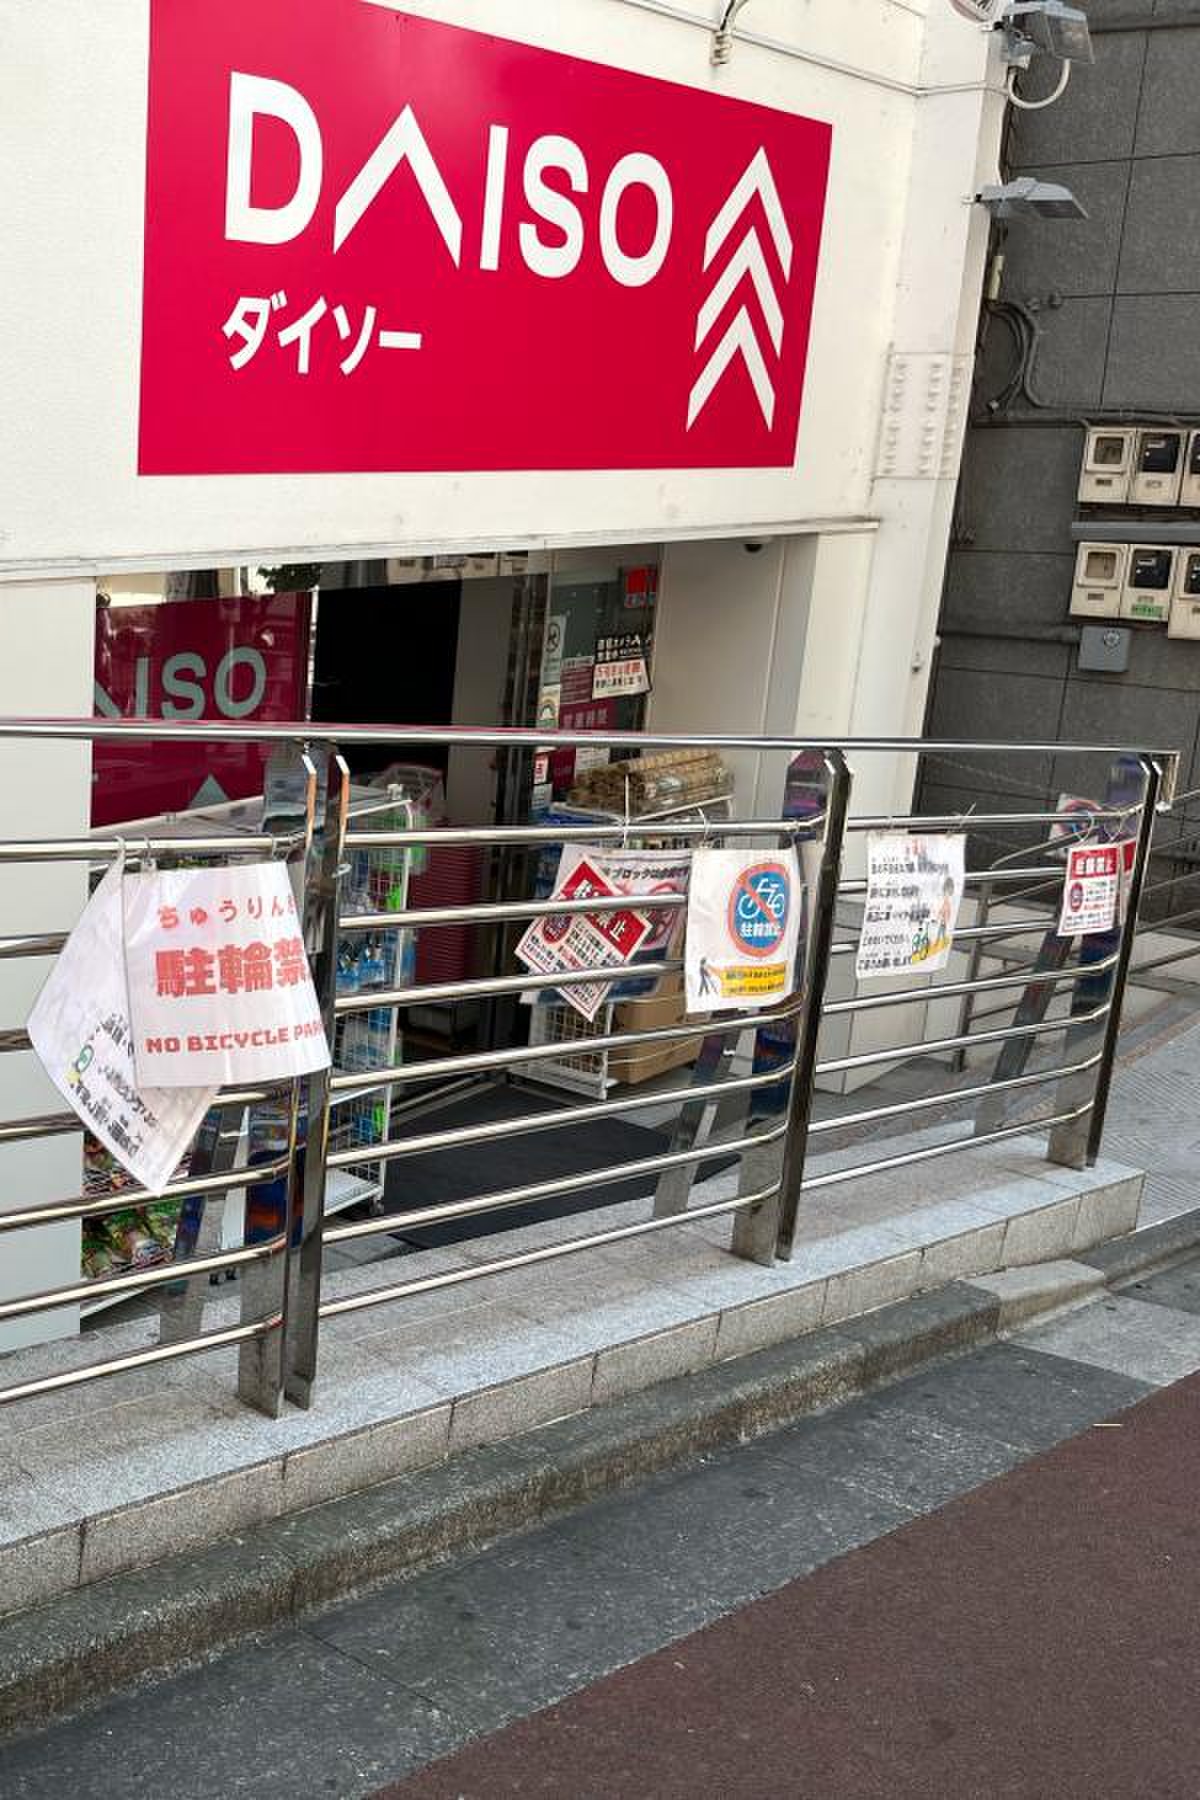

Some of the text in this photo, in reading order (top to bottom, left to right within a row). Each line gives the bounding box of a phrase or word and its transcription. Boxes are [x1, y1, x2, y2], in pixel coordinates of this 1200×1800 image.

[221, 290, 422, 376] ダイソー
[145, 1035, 181, 1054] NO
[187, 1027, 289, 1053] BICYCLE
